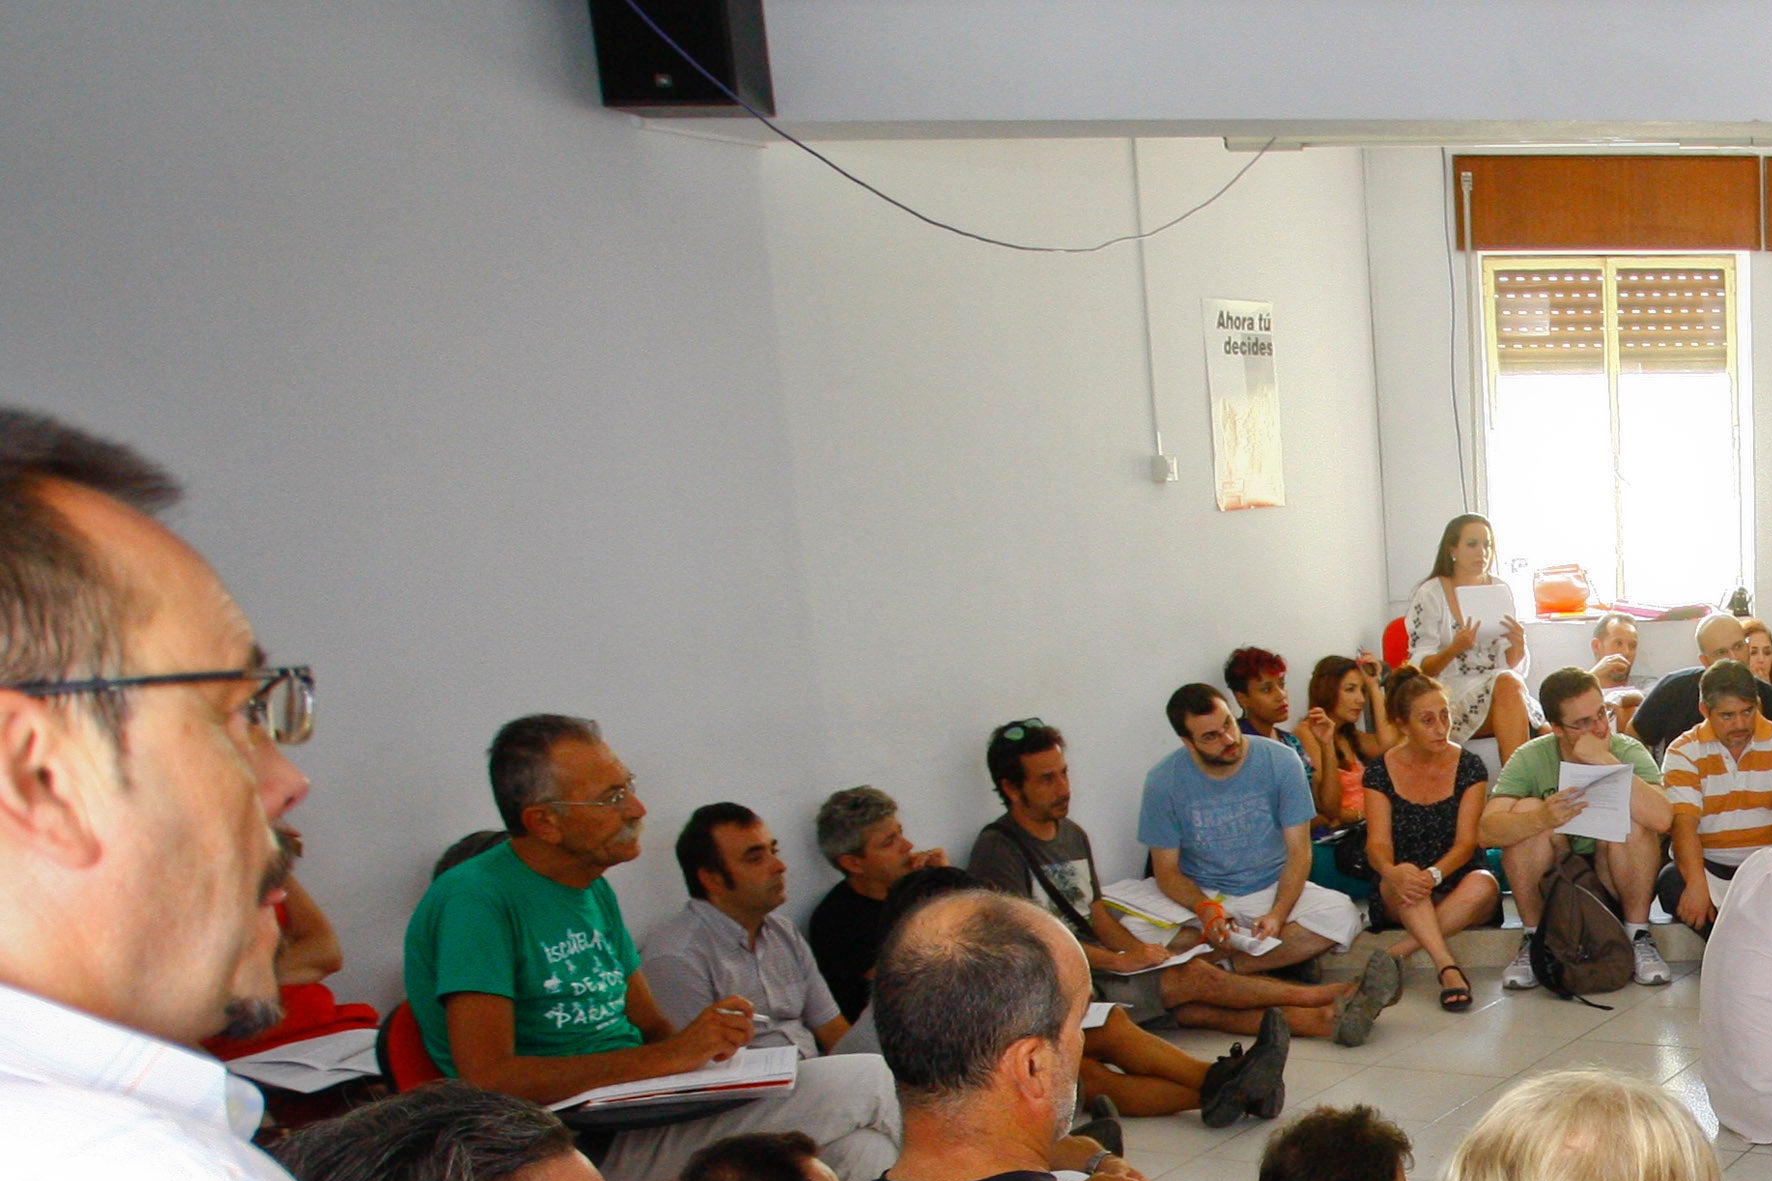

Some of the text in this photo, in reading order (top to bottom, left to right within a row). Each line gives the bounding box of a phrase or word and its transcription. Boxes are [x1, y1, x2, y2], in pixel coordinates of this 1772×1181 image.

[1216, 310, 1271, 331] Ahora tú
[1224, 336, 1273, 356] decides
[570, 977, 597, 996] DE
